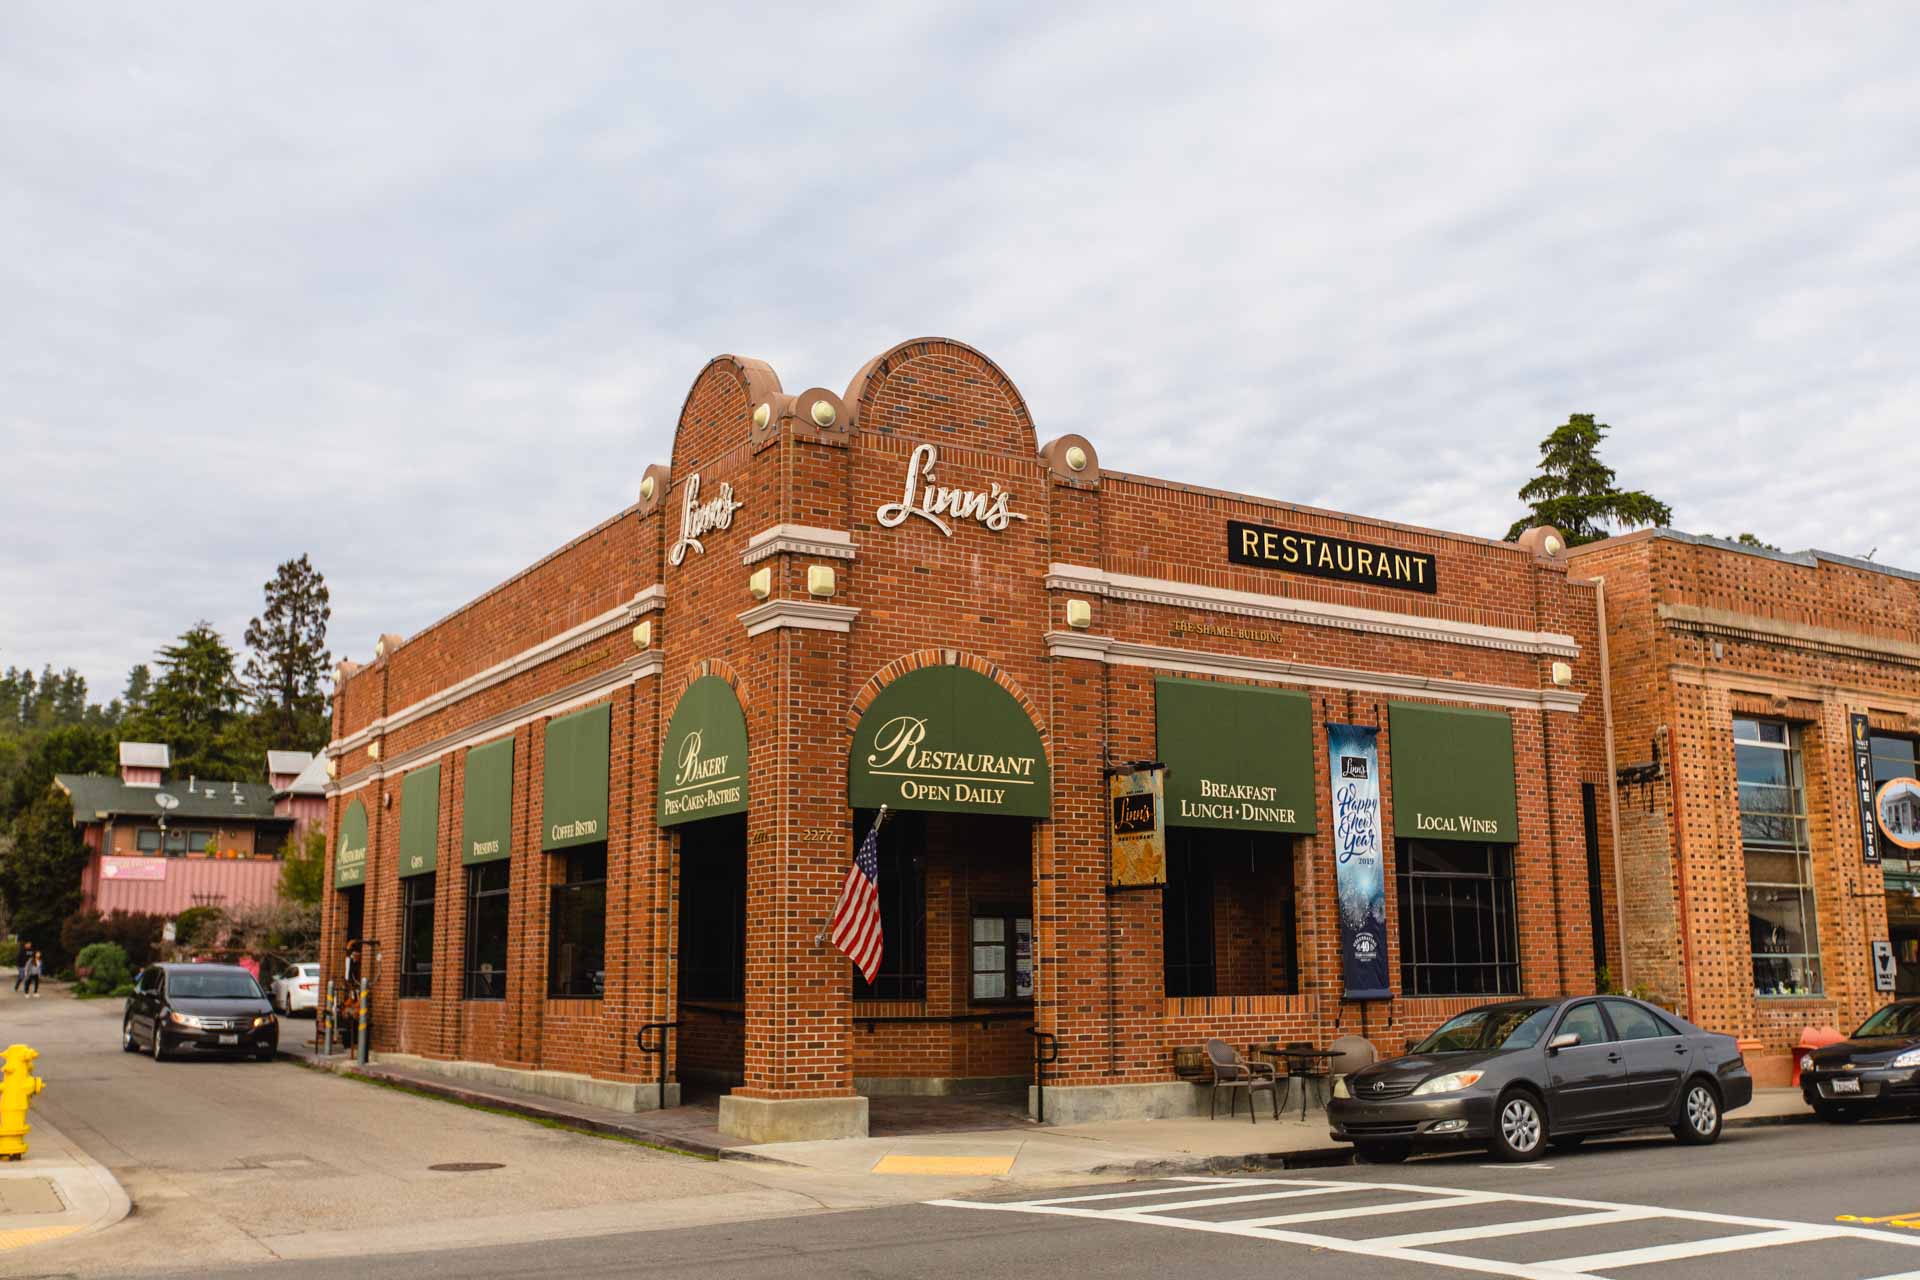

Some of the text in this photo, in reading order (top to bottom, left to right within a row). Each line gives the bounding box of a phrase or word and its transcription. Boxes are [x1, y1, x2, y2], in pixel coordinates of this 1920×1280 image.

[876, 443, 1028, 537] Linn's
[1241, 528, 1428, 584] RESTAURANT
[1174, 621, 1284, 643] THE SHAMEL BUILDING
[675, 728, 729, 786] BAKERY
[867, 716, 1036, 776] RESTAURANT
[900, 780, 1006, 804] OPEN DAILY
[1200, 779, 1277, 801] BREAKFAST
[1860, 757, 1870, 802] FINE
[1180, 799, 1297, 824] LUNCH DINNER
[1337, 783, 1377, 817] Happy
[1114, 797, 1153, 830] Linn's
[1341, 811, 1373, 834] New
[1416, 813, 1498, 834] LOCAL WINES
[552, 819, 597, 841] COFFEE BISTRO
[803, 829, 834, 841] 2277
[1338, 821, 1377, 864] Year
[1865, 810, 1875, 857] ARTS
[1358, 857, 1375, 865] 2019
[1360, 940, 1370, 952] 40
